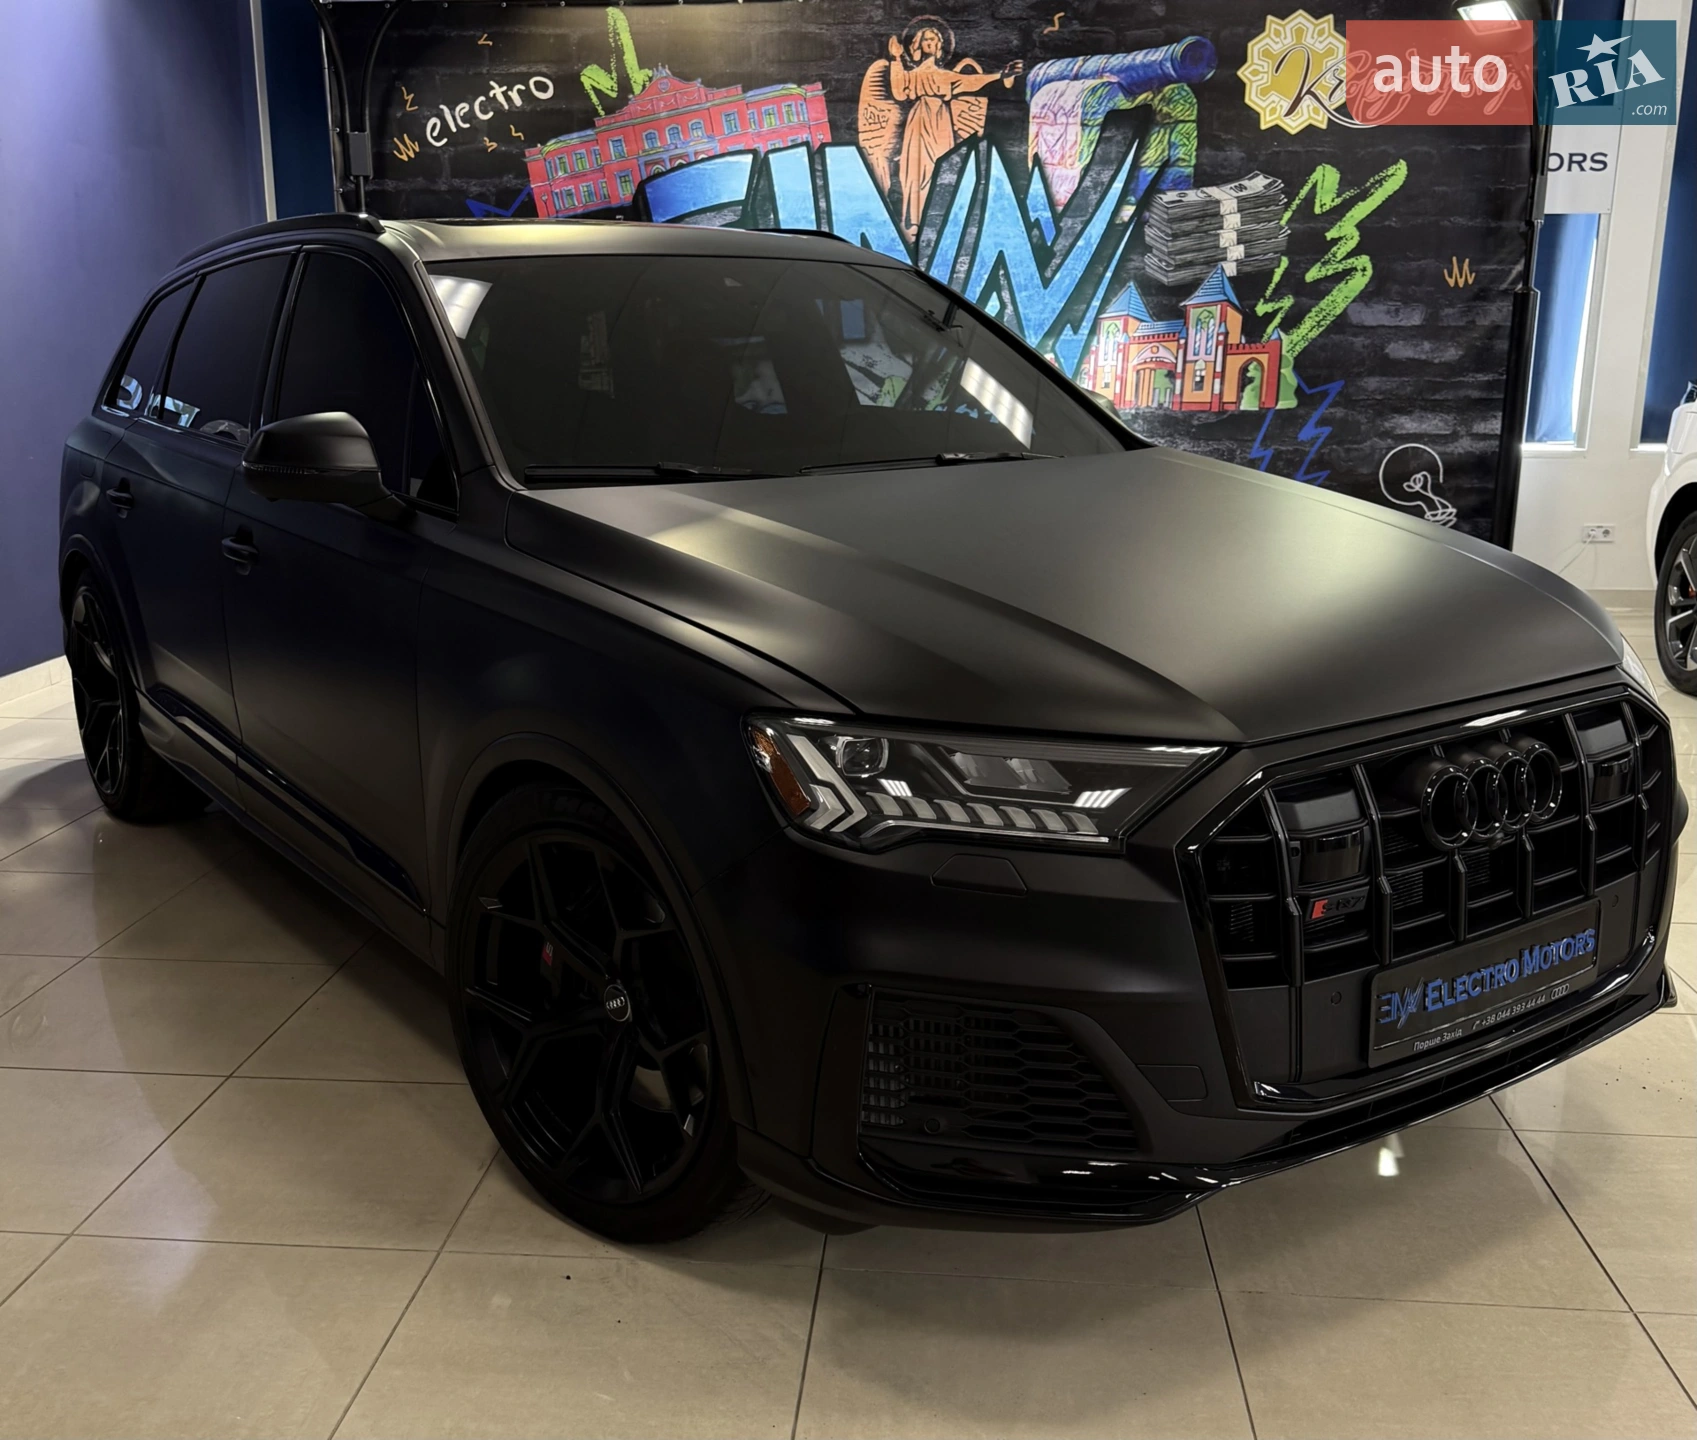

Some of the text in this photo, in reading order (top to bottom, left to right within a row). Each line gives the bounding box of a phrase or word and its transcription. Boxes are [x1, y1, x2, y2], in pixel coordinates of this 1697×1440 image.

[426, 76, 554, 147] electro
[1424, 957, 1519, 1012] ELECTRO
[1520, 928, 1596, 978] MOTORS
[1481, 1013, 1496, 1026] +38
[1496, 1009, 1511, 1021] 044
[1511, 1002, 1526, 1015] 393
[1413, 1028, 1463, 1051] Порше Захід
